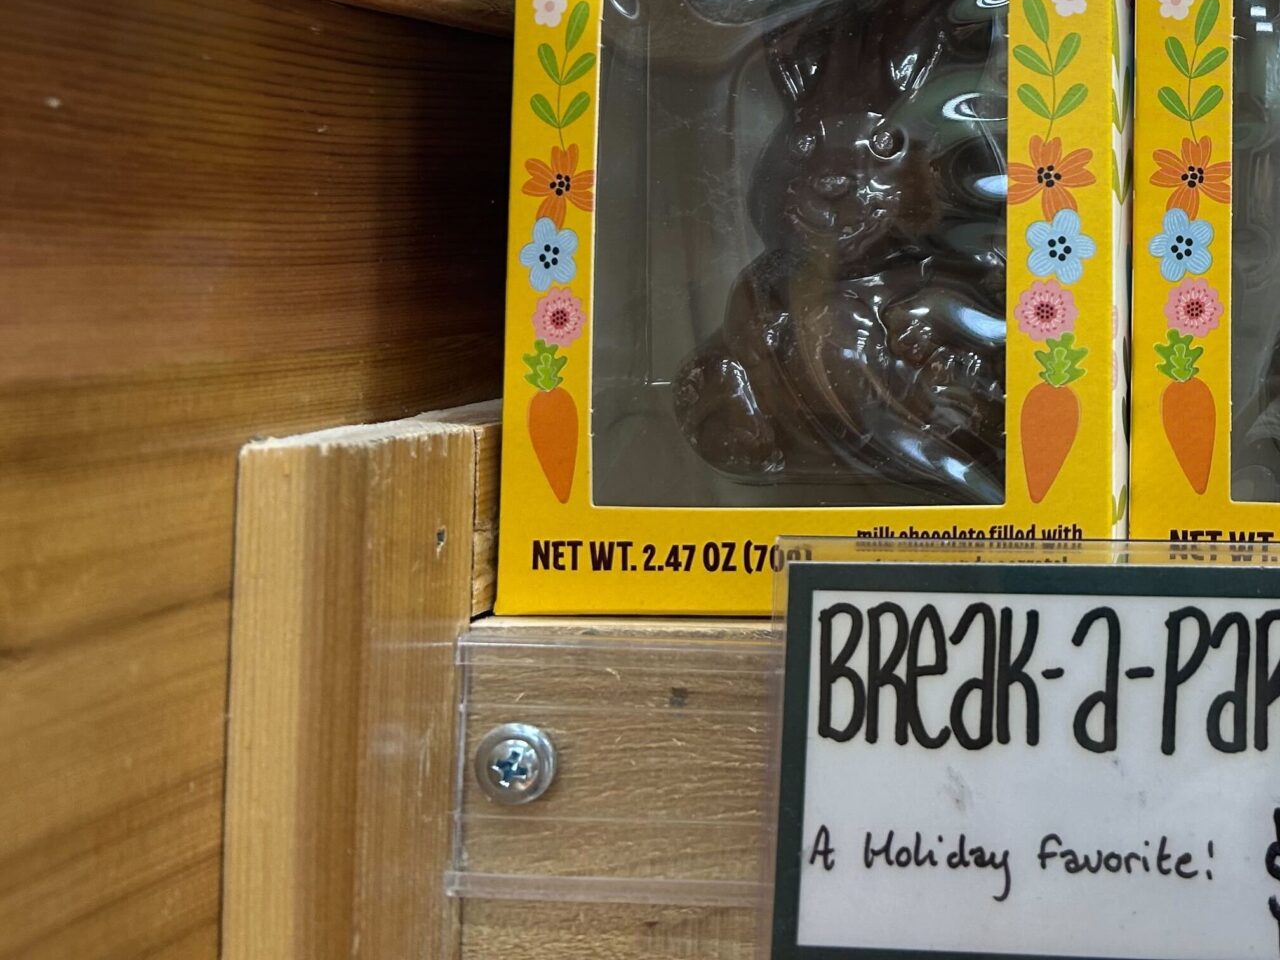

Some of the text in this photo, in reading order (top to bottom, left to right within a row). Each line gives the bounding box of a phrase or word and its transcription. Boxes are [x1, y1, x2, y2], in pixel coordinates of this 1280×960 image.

[532, 540, 583, 570] NET
[590, 541, 637, 571] WT.
[643, 544, 696, 571] 2.47
[703, 542, 737, 572] OZ
[808, 825, 837, 869] A
[862, 830, 1011, 900] Holiday
